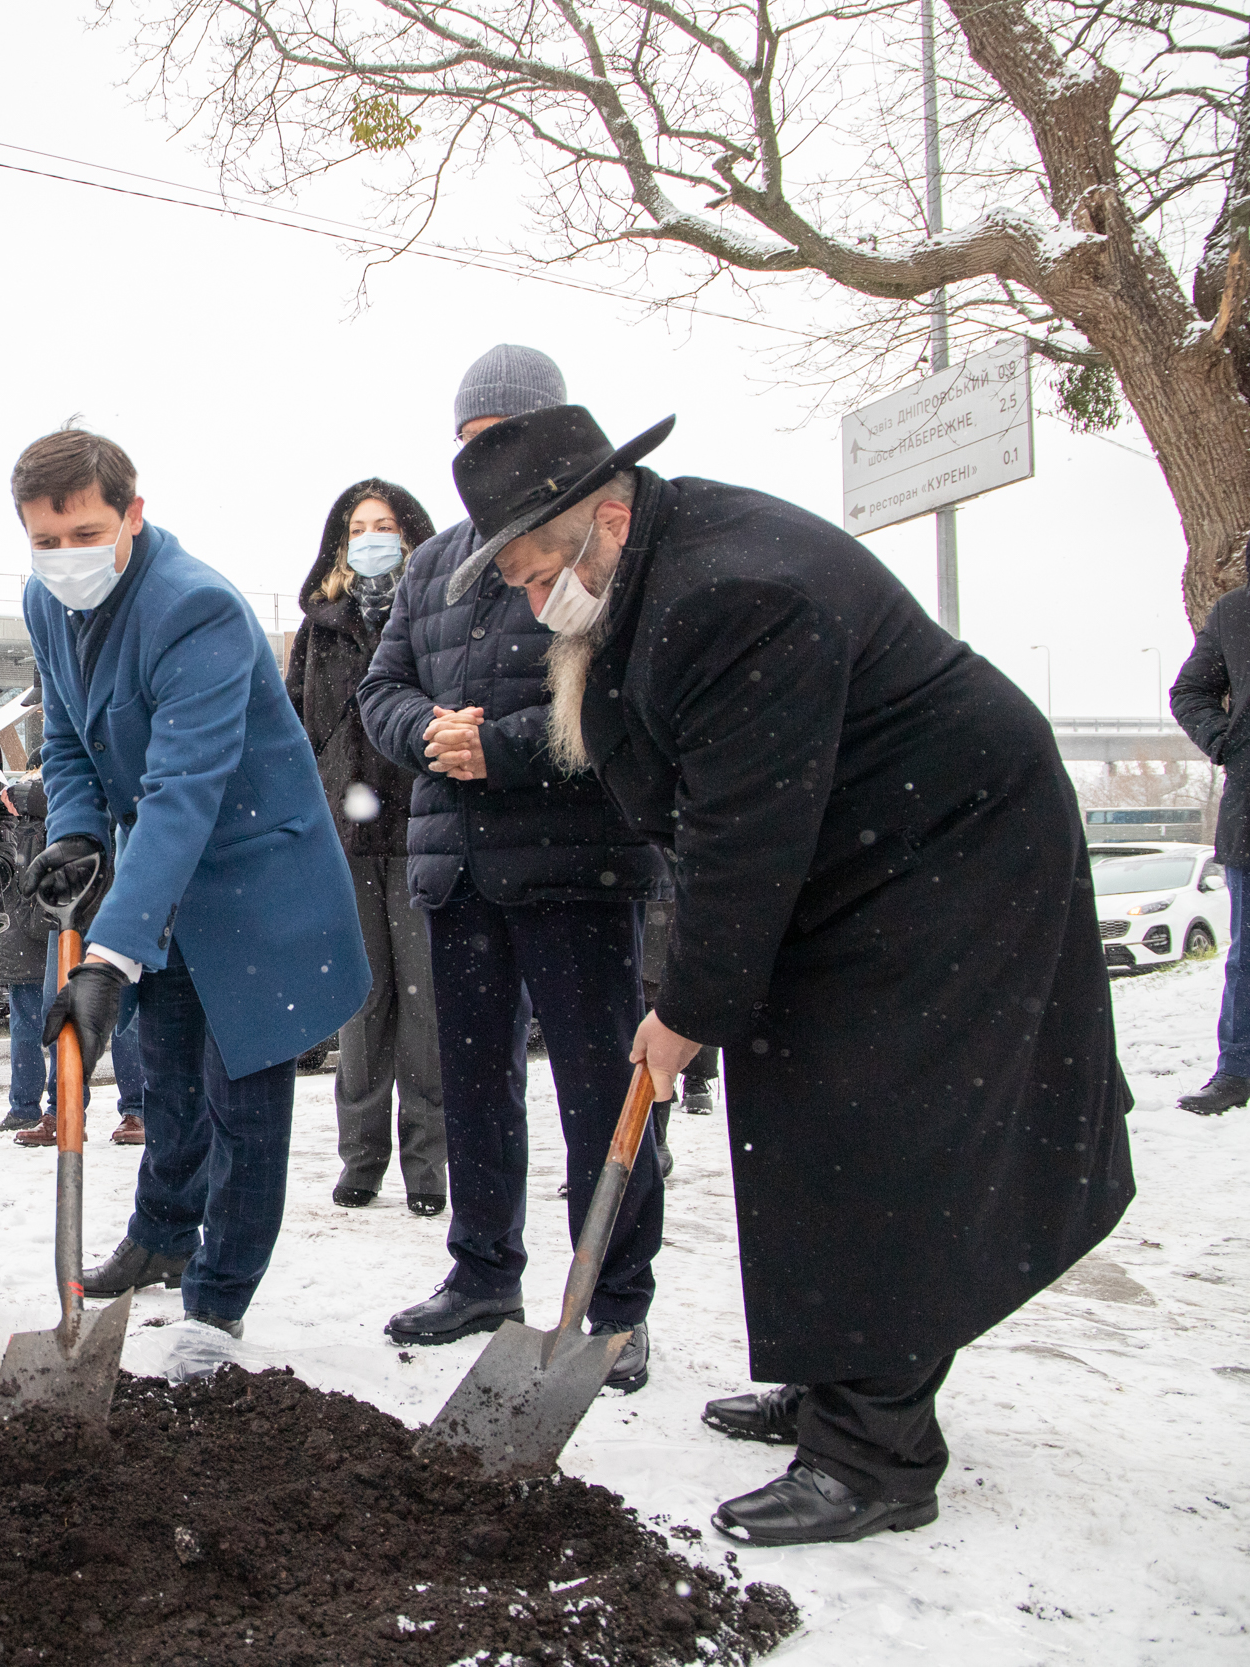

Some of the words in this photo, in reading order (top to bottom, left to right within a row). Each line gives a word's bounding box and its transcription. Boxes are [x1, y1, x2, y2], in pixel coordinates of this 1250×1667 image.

[868, 448, 894, 467] шосе
[899, 411, 973, 454] НАБЕРЕЖНЕ
[999, 394, 1017, 413] 2,5
[897, 370, 990, 425] ДНІПРОВСЬКИЙ
[869, 486, 918, 516] ресторан
[921, 465, 978, 493] «КУРЕНІ»
[1003, 448, 1019, 465] 0,1
